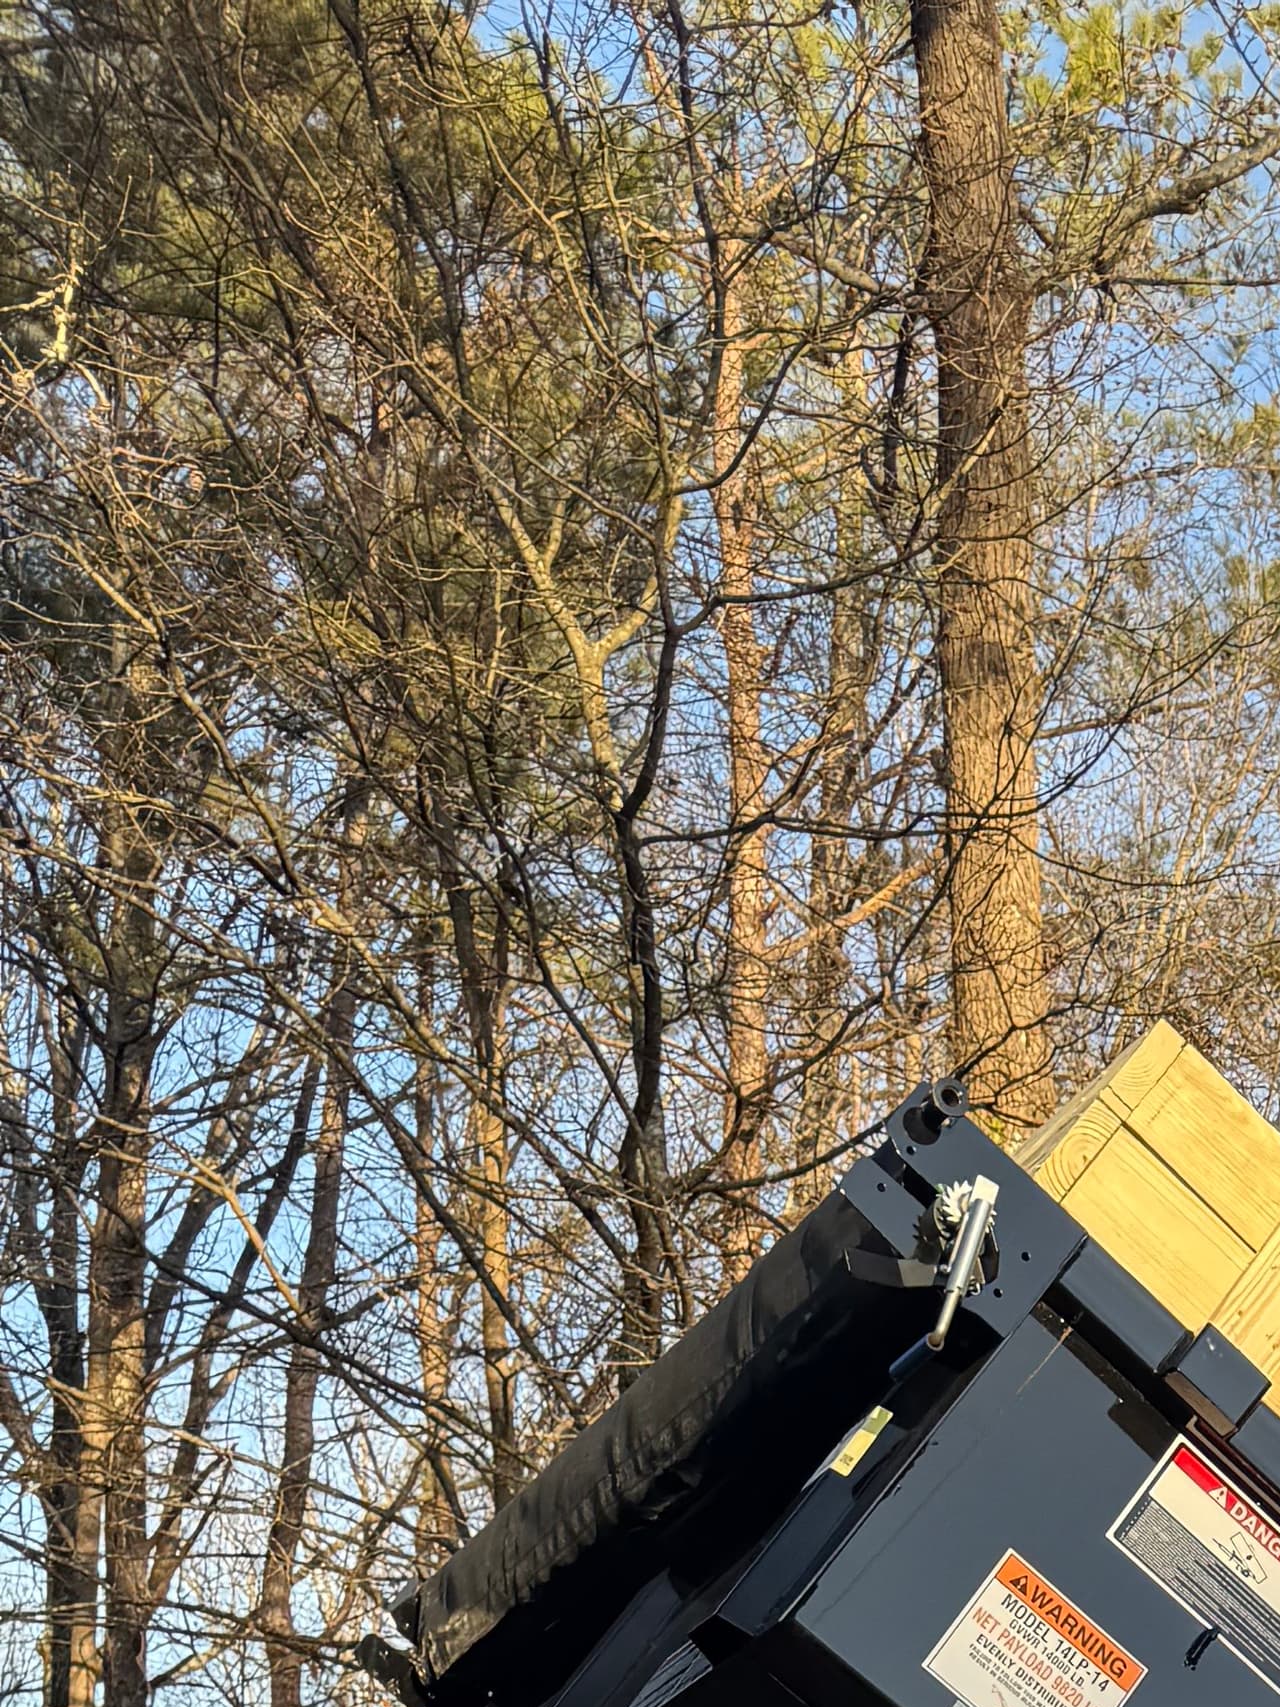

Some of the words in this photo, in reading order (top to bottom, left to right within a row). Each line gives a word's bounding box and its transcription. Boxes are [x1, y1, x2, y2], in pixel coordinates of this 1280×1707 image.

[972, 1607, 1001, 1634] NET
[997, 1629, 1053, 1681] PAYLOAD
[1051, 1676, 1083, 1707] 9820
[976, 1634, 1016, 1669] EVENLY
[1001, 1594, 1050, 1643] MODEL
[1055, 1639, 1110, 1692] 14LP-14
[1009, 1619, 1041, 1649] GVWR
[1041, 1646, 1071, 1675] 14000
[1031, 1585, 1128, 1679] WARNING
